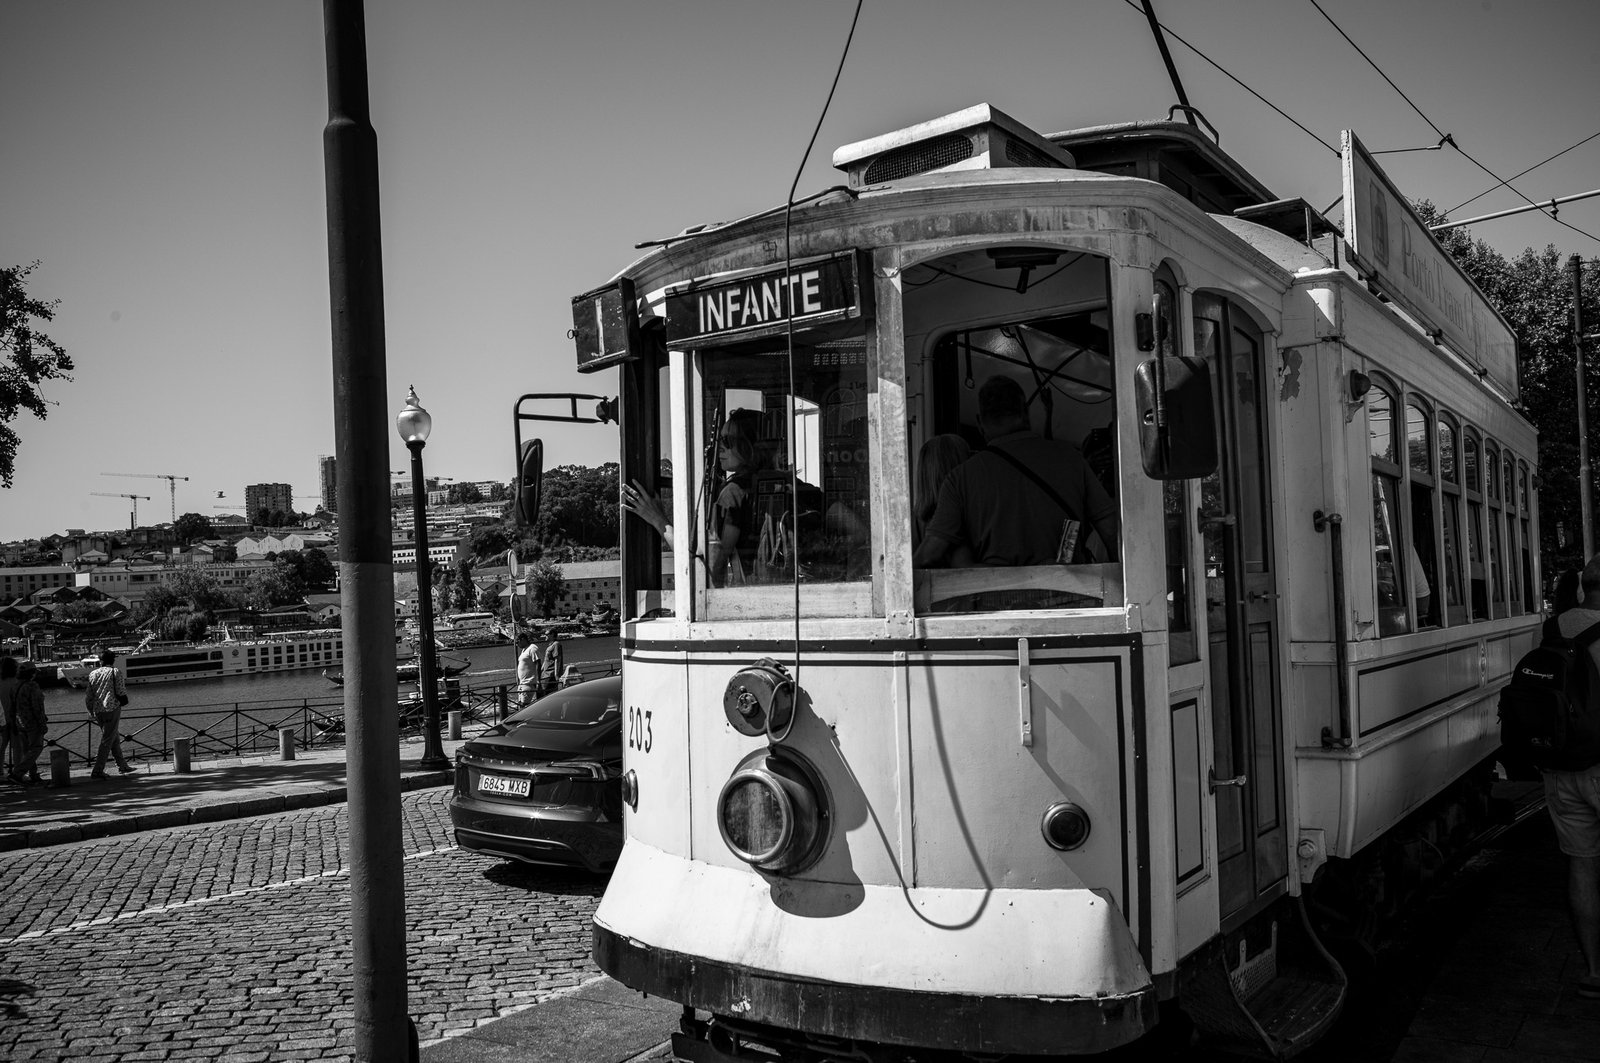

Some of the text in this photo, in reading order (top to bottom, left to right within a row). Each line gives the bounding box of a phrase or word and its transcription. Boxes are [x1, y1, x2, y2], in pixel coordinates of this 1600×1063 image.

[699, 269, 822, 334] INFANTE
[1400, 215, 1435, 303] Porto
[1433, 257, 1464, 332] Tram
[629, 705, 653, 754] 203
[483, 777, 505, 791] 6845
[509, 780, 528, 794] MXB
